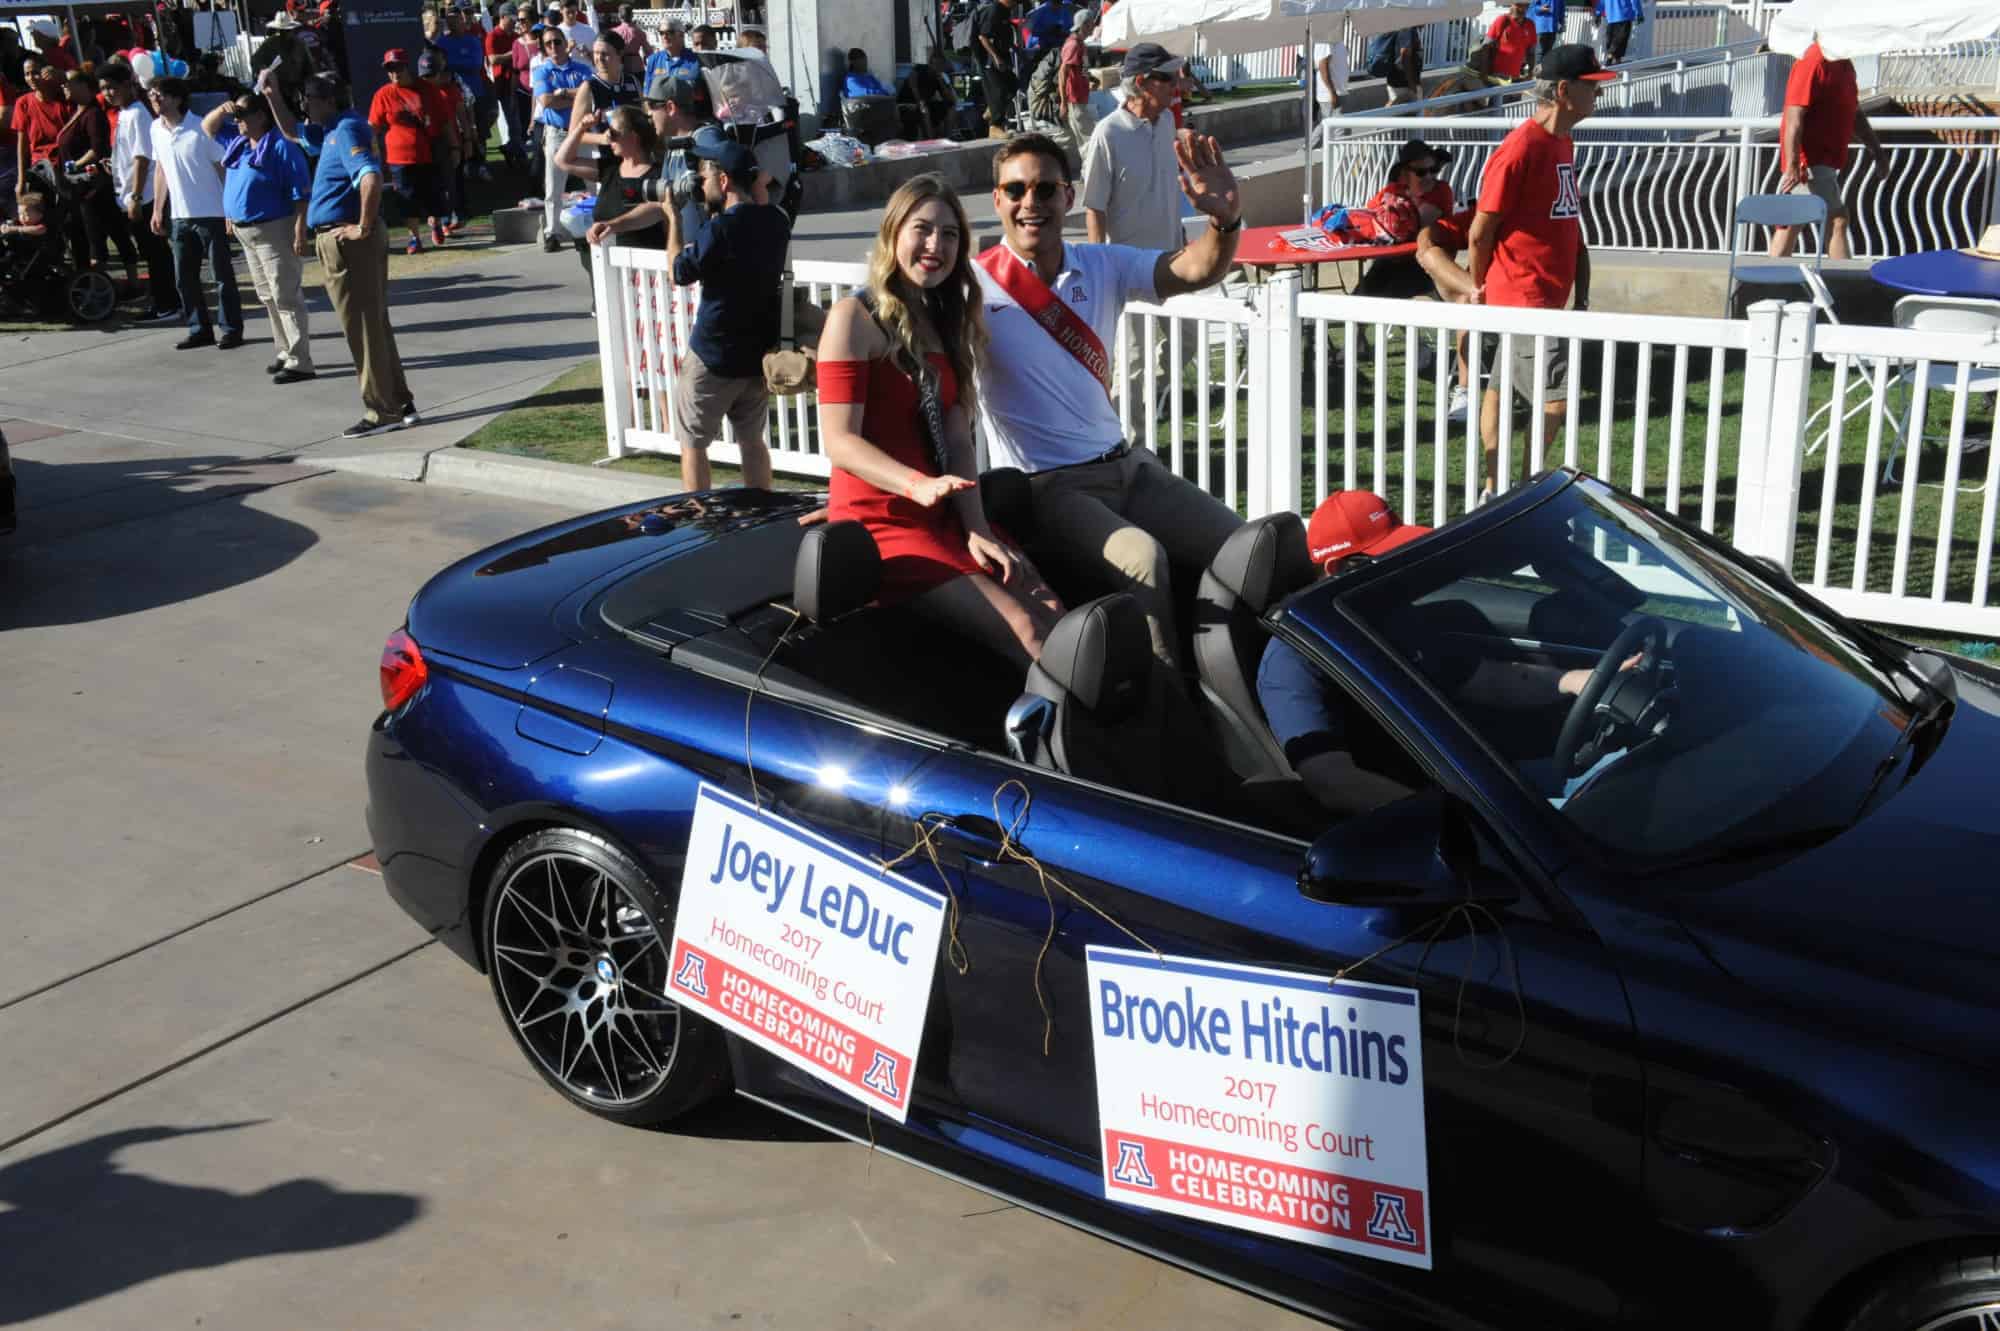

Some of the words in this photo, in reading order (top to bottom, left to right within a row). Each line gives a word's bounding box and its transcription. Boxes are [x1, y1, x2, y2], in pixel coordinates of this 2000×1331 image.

[1060, 326, 1107, 382] HOMECO
[710, 823, 795, 914] Joey
[799, 863, 914, 966] LeDuc
[710, 917, 830, 1000] Homecoming
[832, 981, 886, 1025] Court
[780, 923, 822, 960] 2017
[719, 993, 855, 1075] CELEBRATION
[722, 969, 857, 1057] HOMECOMING
[1099, 979, 1232, 1057] Brooke
[1241, 995, 1409, 1086] Hitchins
[1140, 1092, 1298, 1153] Homecoming
[1304, 1123, 1375, 1161] Court
[1223, 1076, 1278, 1109] 2017
[1168, 1148, 1350, 1206] HOMECOMING
[1170, 1173, 1352, 1230] CELEBRATION
